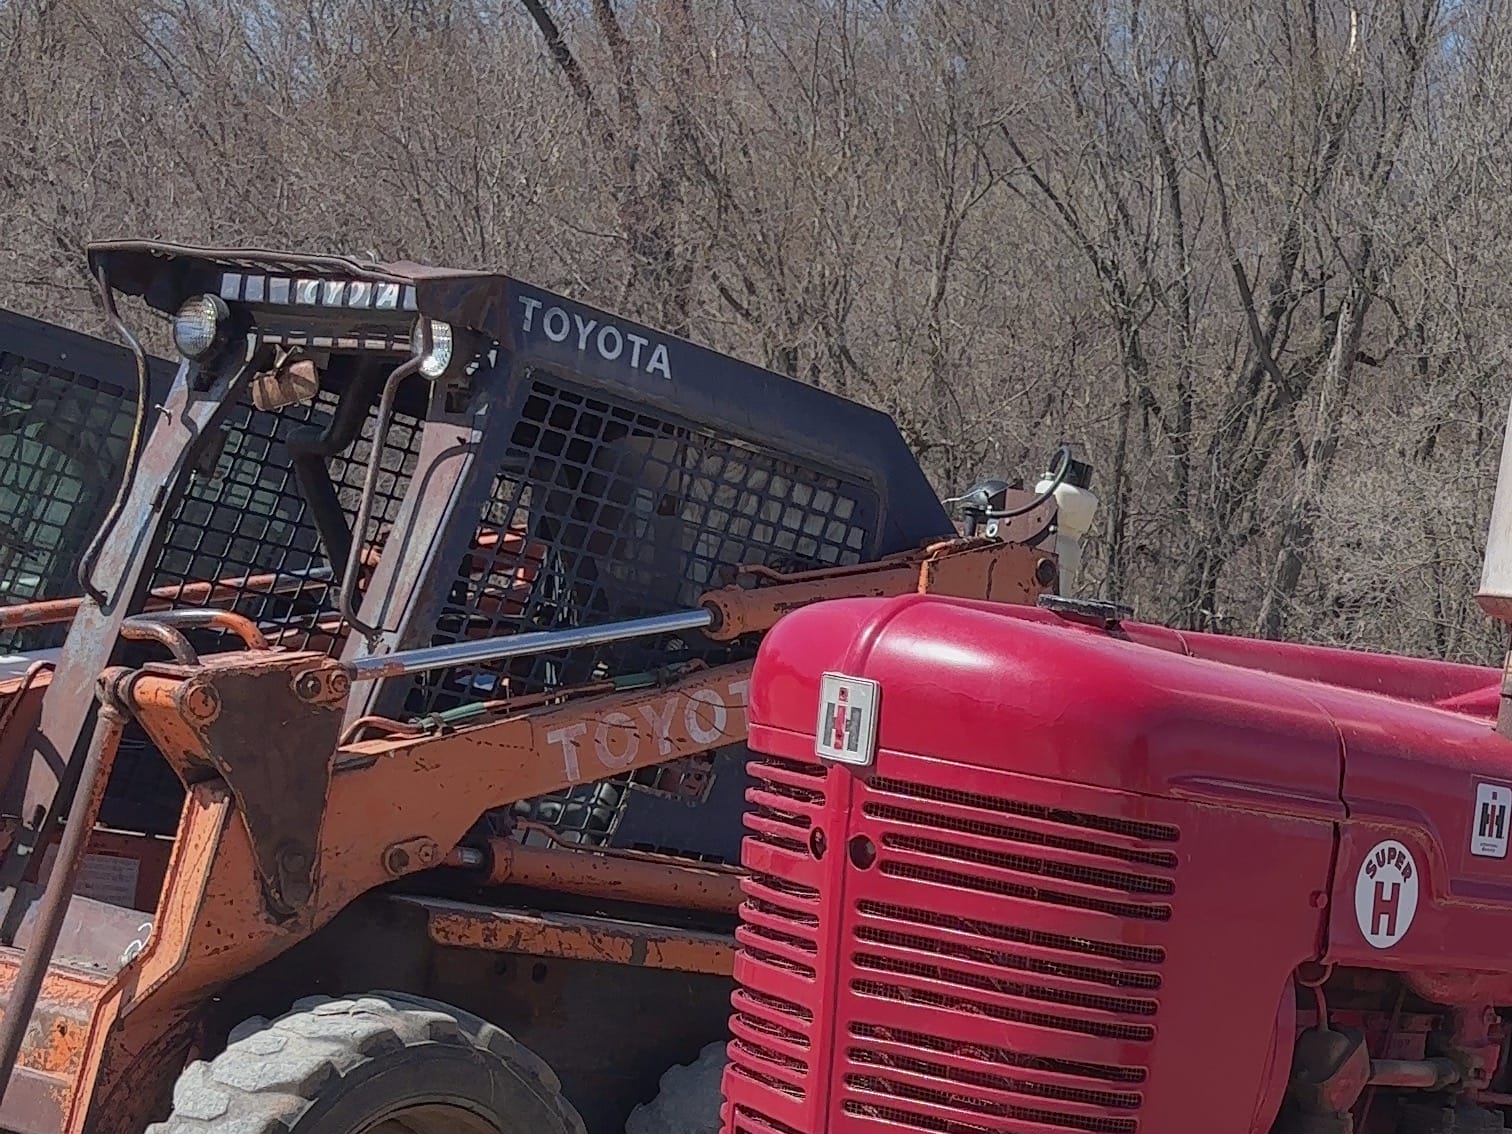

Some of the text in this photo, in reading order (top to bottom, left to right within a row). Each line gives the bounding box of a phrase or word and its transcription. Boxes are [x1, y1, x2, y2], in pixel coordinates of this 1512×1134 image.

[518, 295, 672, 380] TOYOTA
[1365, 846, 1413, 884] SUPER
[1370, 880, 1401, 937] H
